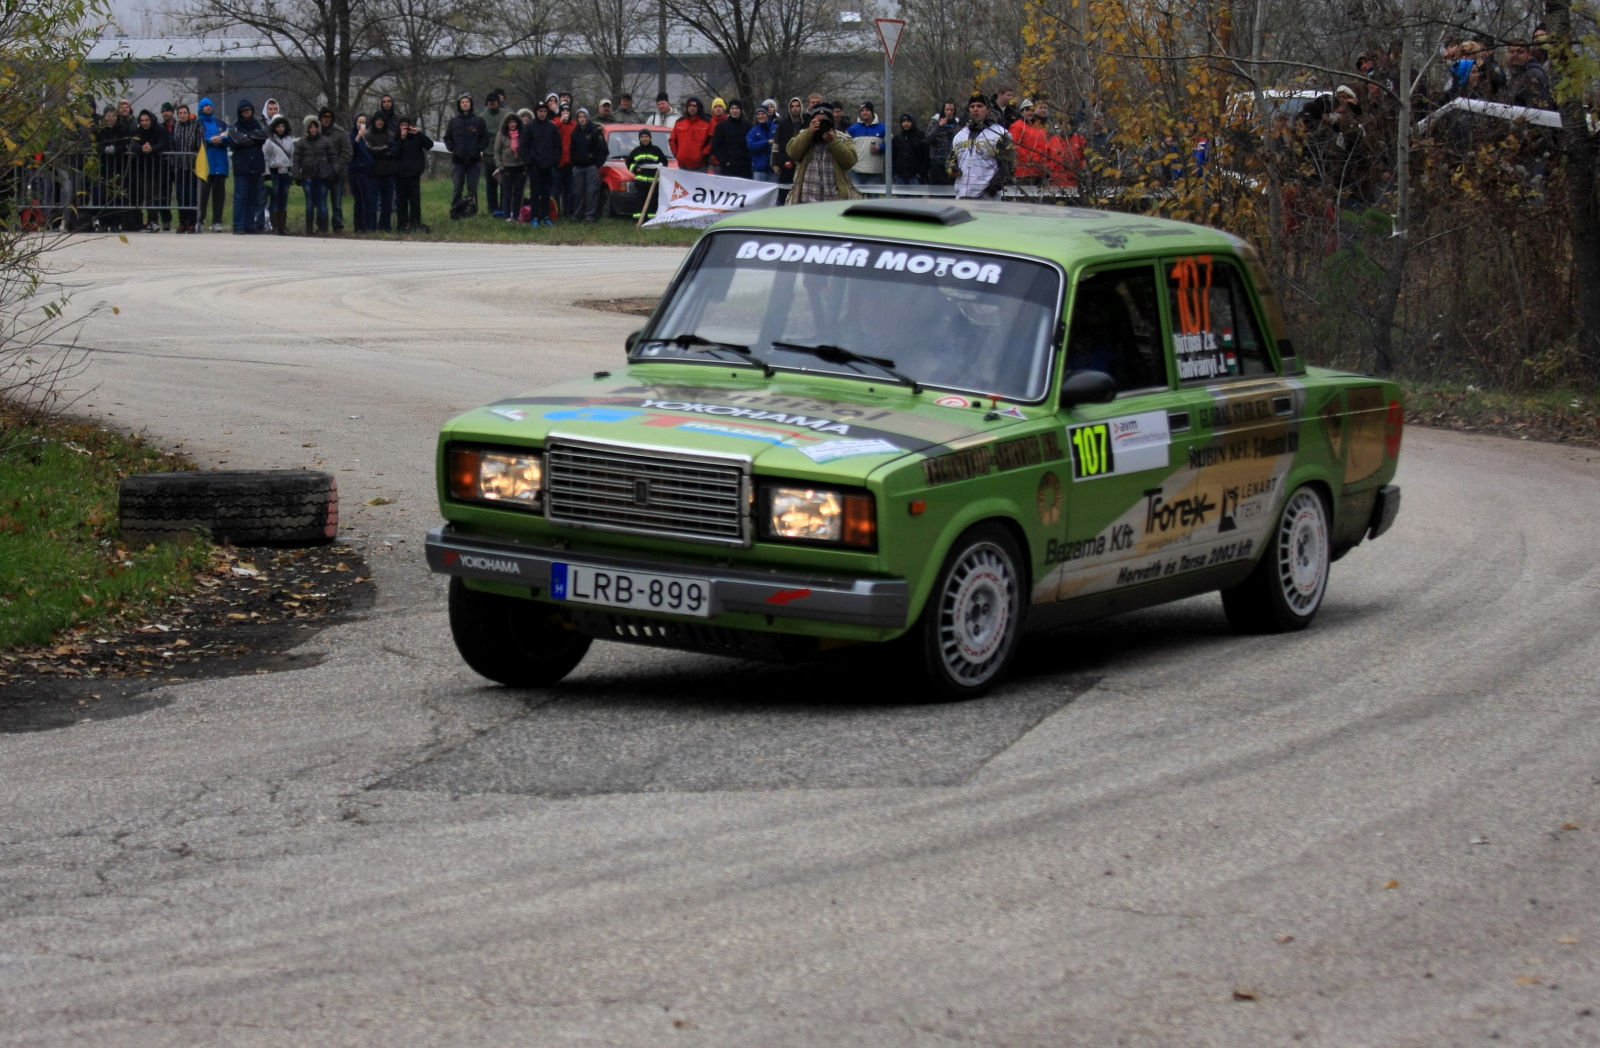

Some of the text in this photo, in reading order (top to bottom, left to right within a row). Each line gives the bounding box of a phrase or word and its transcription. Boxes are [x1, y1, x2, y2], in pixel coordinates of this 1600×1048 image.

[692, 186, 747, 208] avm
[736, 241, 1001, 284] BODNÁR MOTOR
[1171, 254, 1212, 336] 107
[641, 399, 850, 435] YOKOHAMA
[1120, 420, 1138, 432] avm
[1232, 402, 1255, 424] STAR
[1073, 424, 1107, 477] 107
[1189, 446, 1226, 469] RUBIN
[1240, 501, 1261, 518] TECH
[1044, 534, 1106, 565] Bezama
[1110, 523, 1134, 552] Kft
[459, 555, 521, 575] YOKOHAMA
[555, 569, 703, 612] H LRB-899
